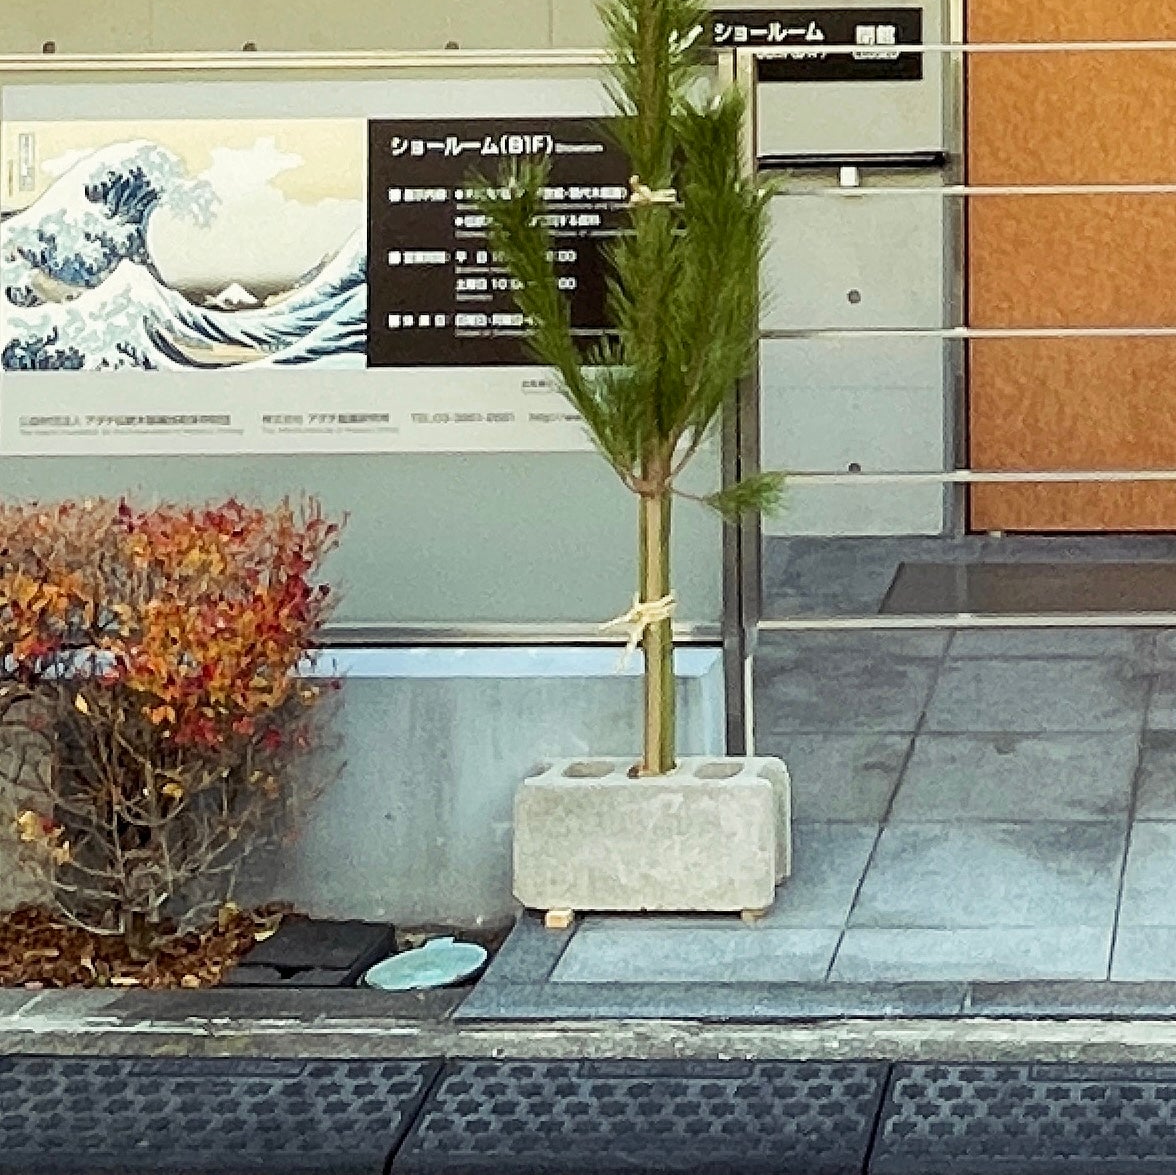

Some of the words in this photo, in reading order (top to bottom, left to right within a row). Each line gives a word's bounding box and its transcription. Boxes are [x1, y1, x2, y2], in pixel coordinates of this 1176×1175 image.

[714, 21, 824, 42] ショールーム
